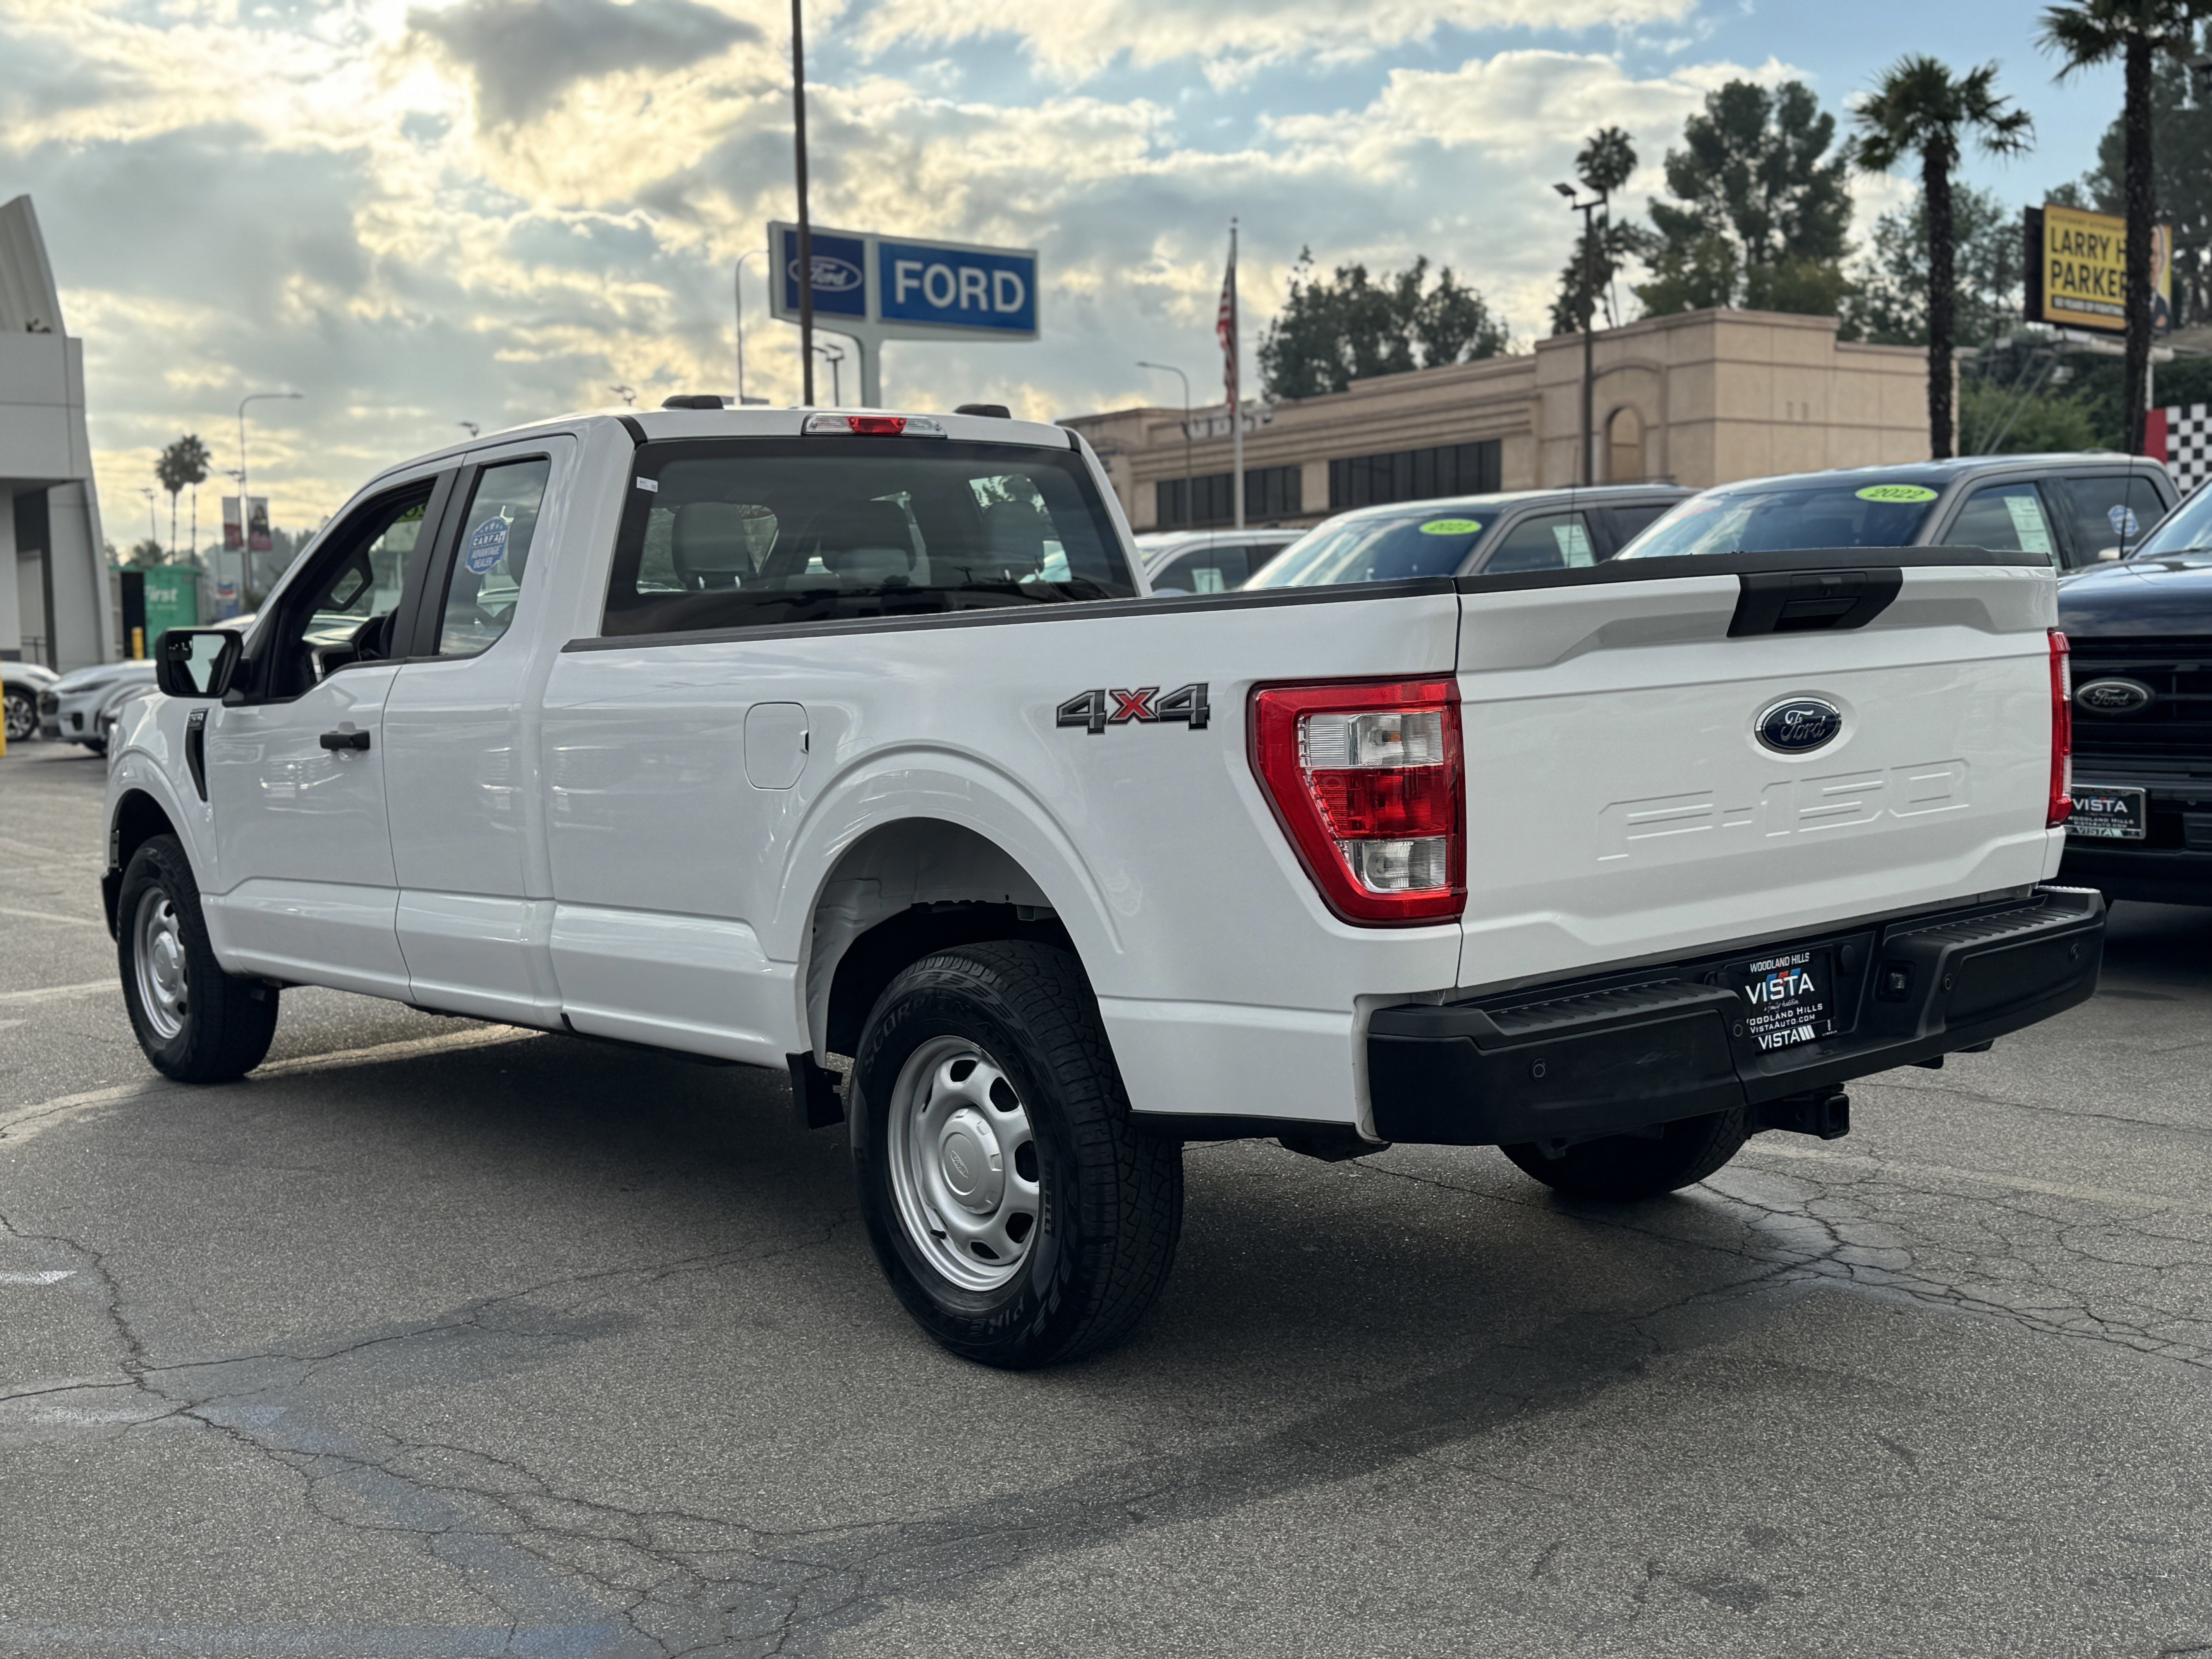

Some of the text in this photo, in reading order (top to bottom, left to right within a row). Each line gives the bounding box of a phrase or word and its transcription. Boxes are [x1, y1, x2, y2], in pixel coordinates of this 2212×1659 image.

[2051, 227, 2110, 261] LARRY
[895, 259, 1025, 313] FORD
[2051, 260, 2127, 299] PARKER
[1867, 488, 1925, 499] 2022
[473, 533, 505, 546] CARFAX
[472, 546, 500, 558] ADVANTAGE
[474, 557, 493, 568] DEALER
[2092, 688, 2129, 706] Ford
[1781, 709, 1826, 741] Ford
[1597, 758, 1970, 860] F-150
[2072, 799, 2128, 812] VISTA
[2077, 827, 2112, 836] VISTA
[1750, 952, 1810, 973] WOODLAND HILLS
[1745, 973, 1815, 1004] VISTA
[1796, 1003, 1822, 1014] HILLS
[1758, 1029, 1800, 1050] VISTA
